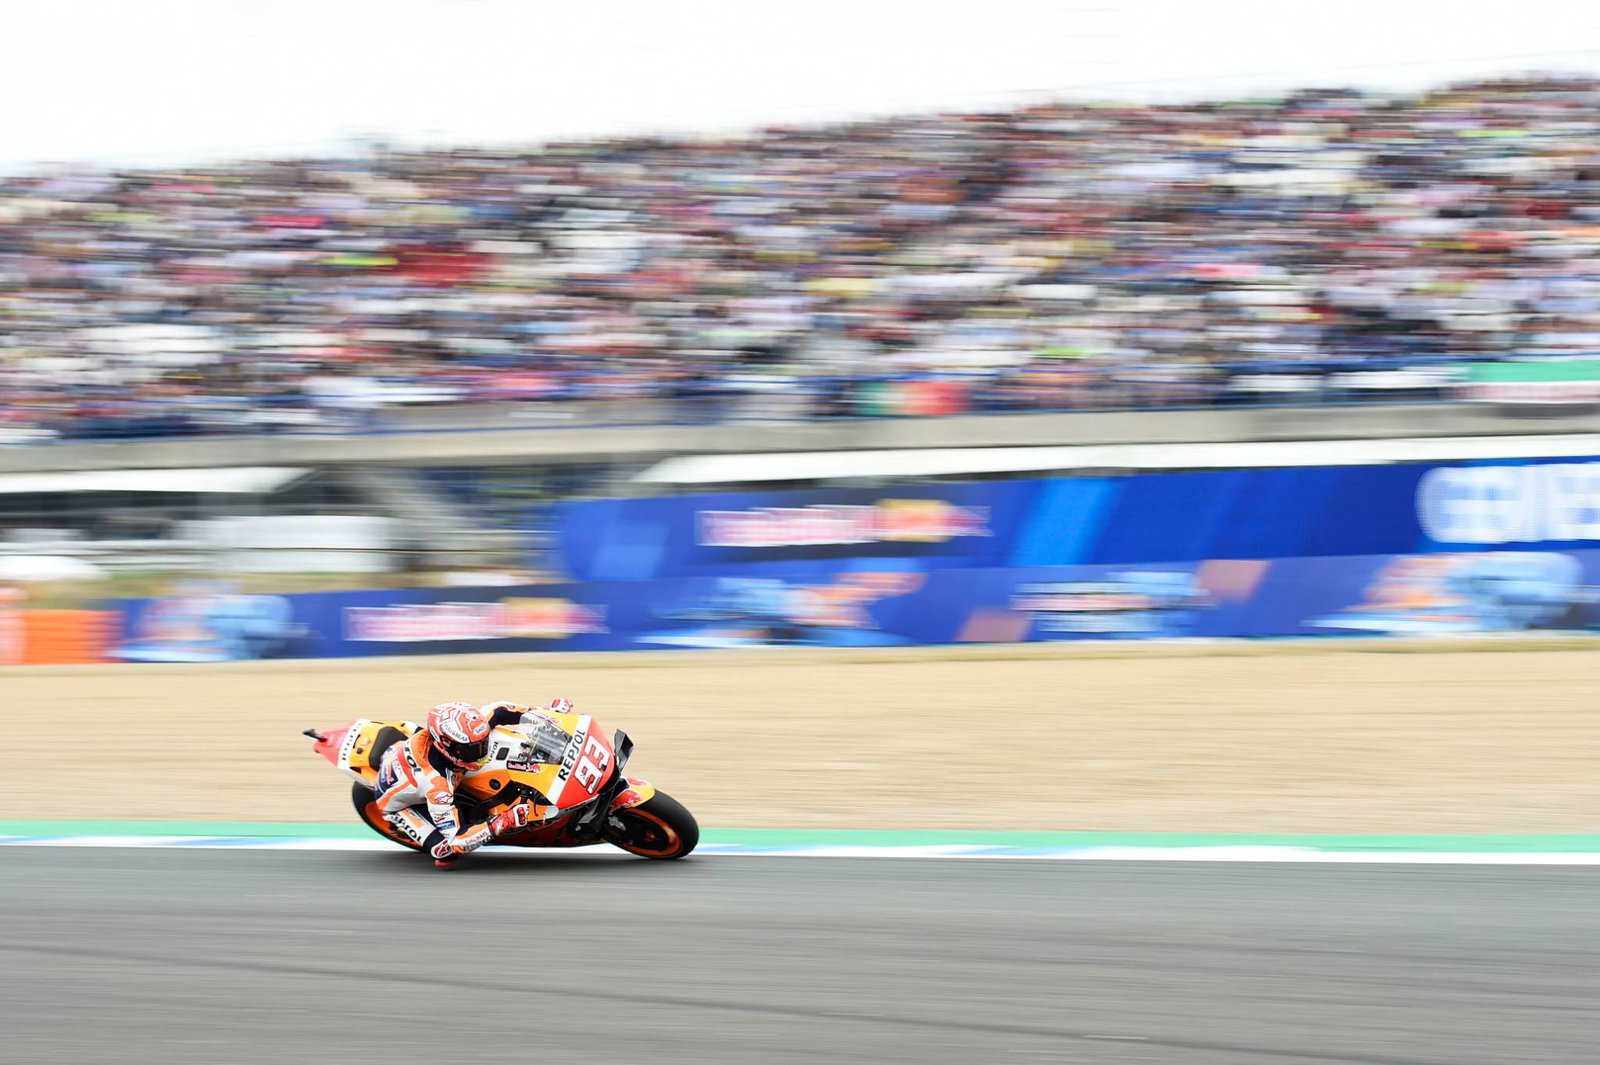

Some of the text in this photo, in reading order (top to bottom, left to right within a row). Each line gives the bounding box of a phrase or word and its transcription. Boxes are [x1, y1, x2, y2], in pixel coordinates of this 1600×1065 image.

[558, 730, 586, 782] REPSOL
[574, 735, 610, 794] 93
[391, 812, 422, 842] EPSOL
